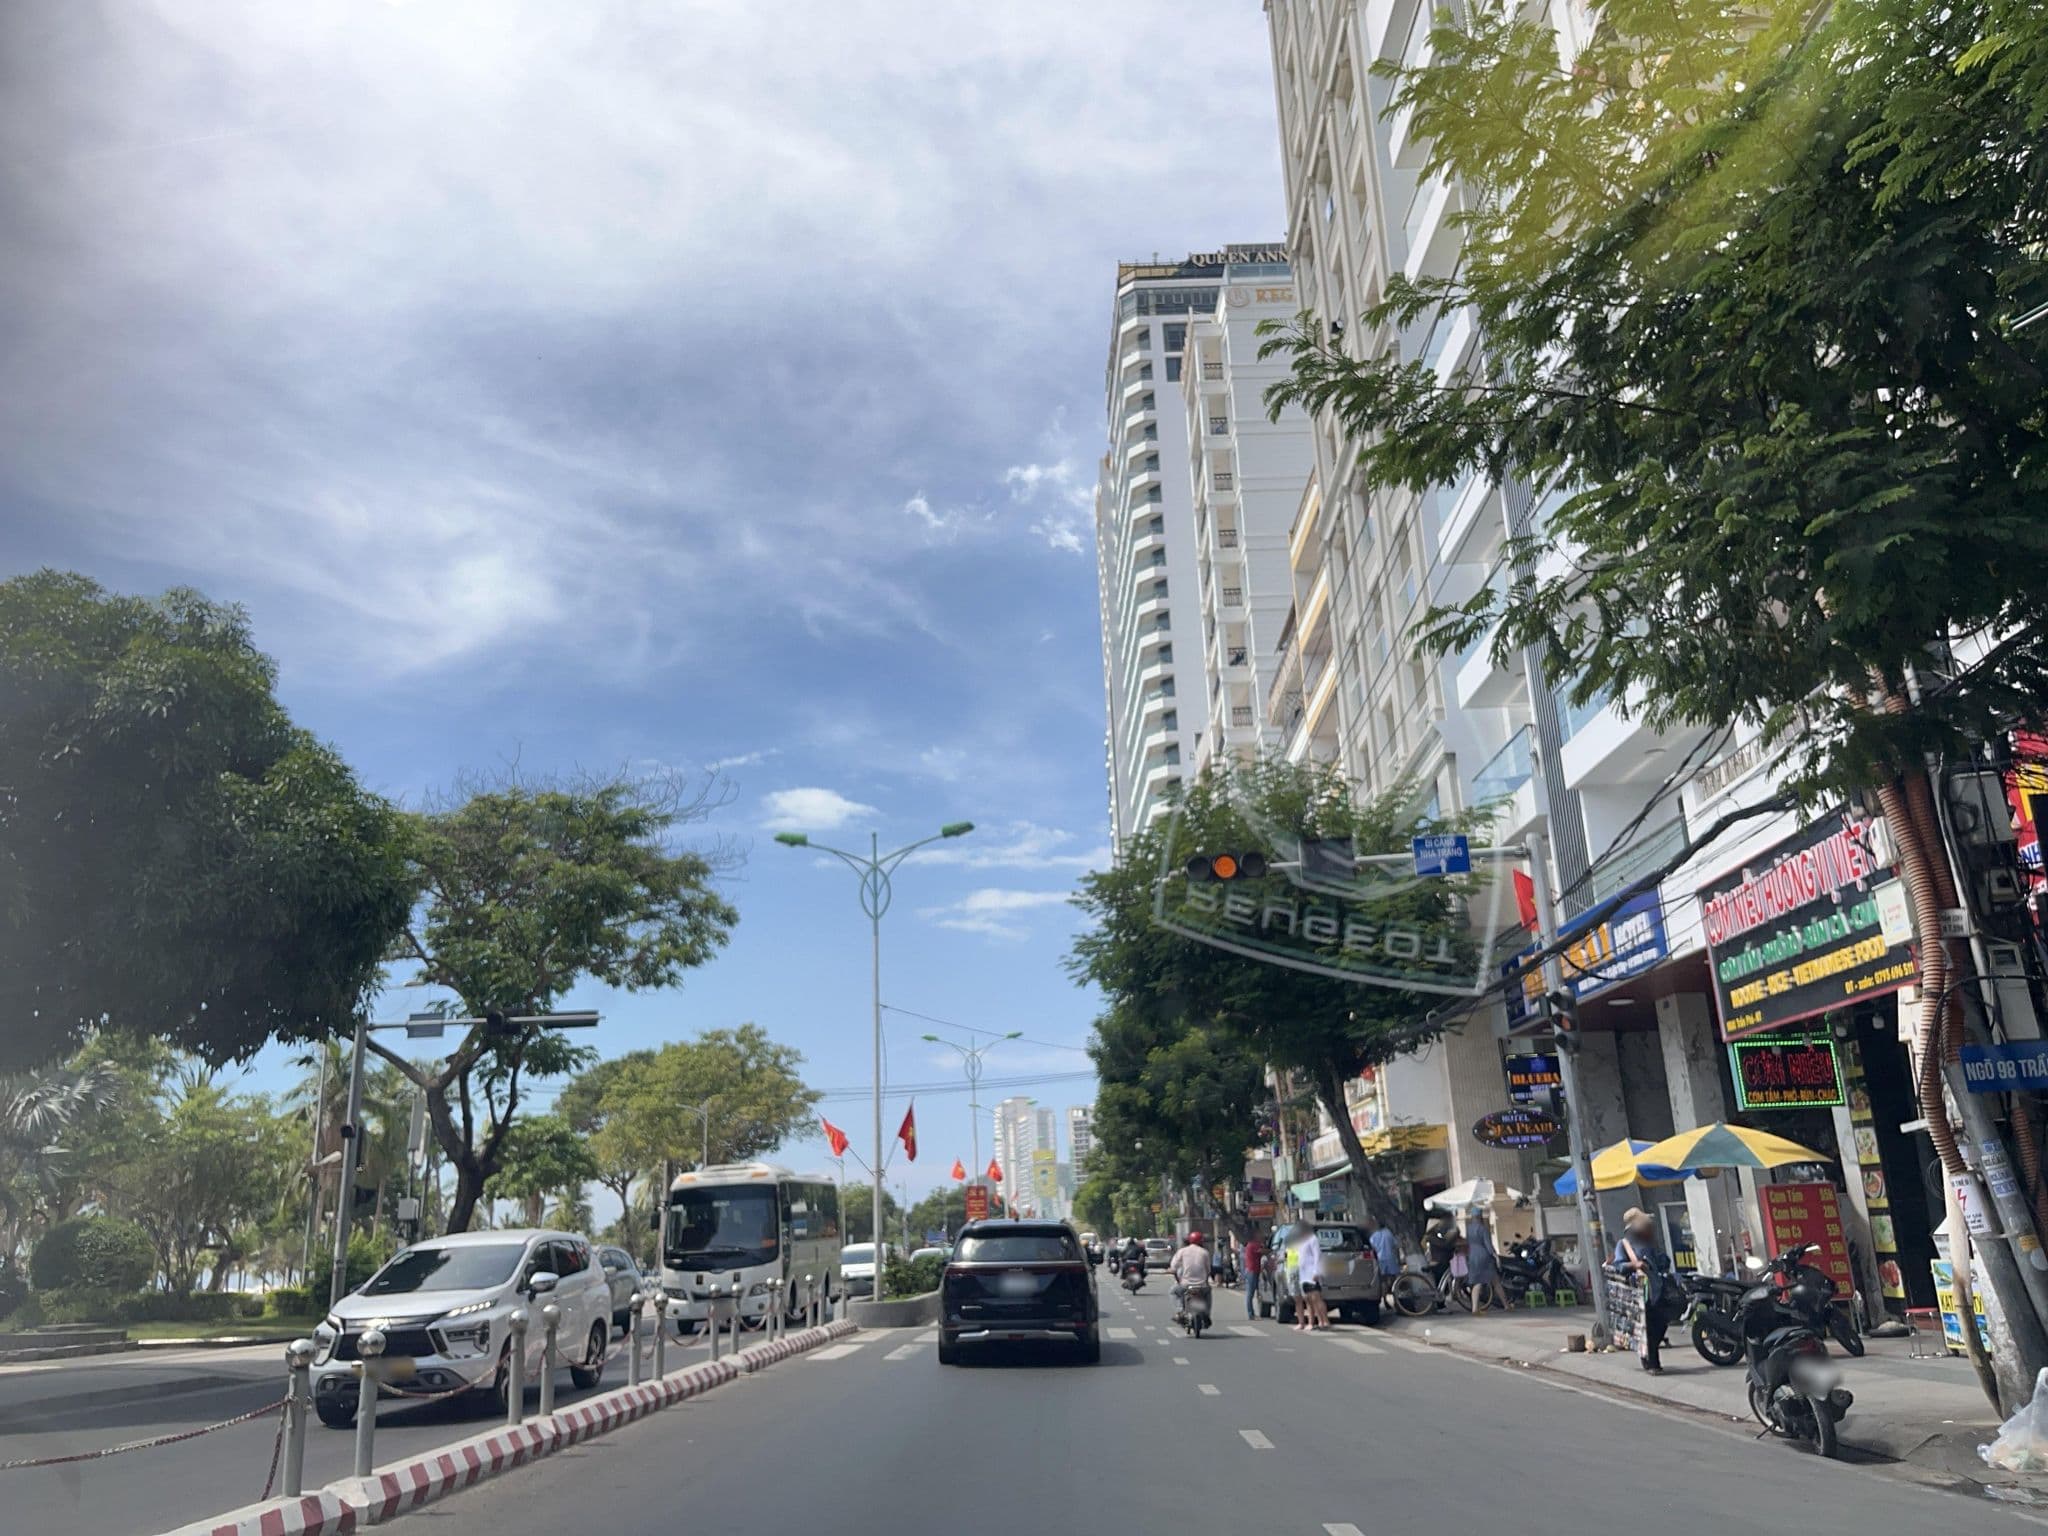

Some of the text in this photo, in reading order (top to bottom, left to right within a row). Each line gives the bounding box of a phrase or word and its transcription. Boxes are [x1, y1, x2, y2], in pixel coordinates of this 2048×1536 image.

[1192, 250, 1289, 267] QUEEN ANN
[1256, 288, 1294, 303] REG
[1966, 1053, 2048, 1081] NGÕ 98 TRẦ
[1502, 1114, 1529, 1123] HOTEL
[1320, 1231, 1339, 1239] TAXI
